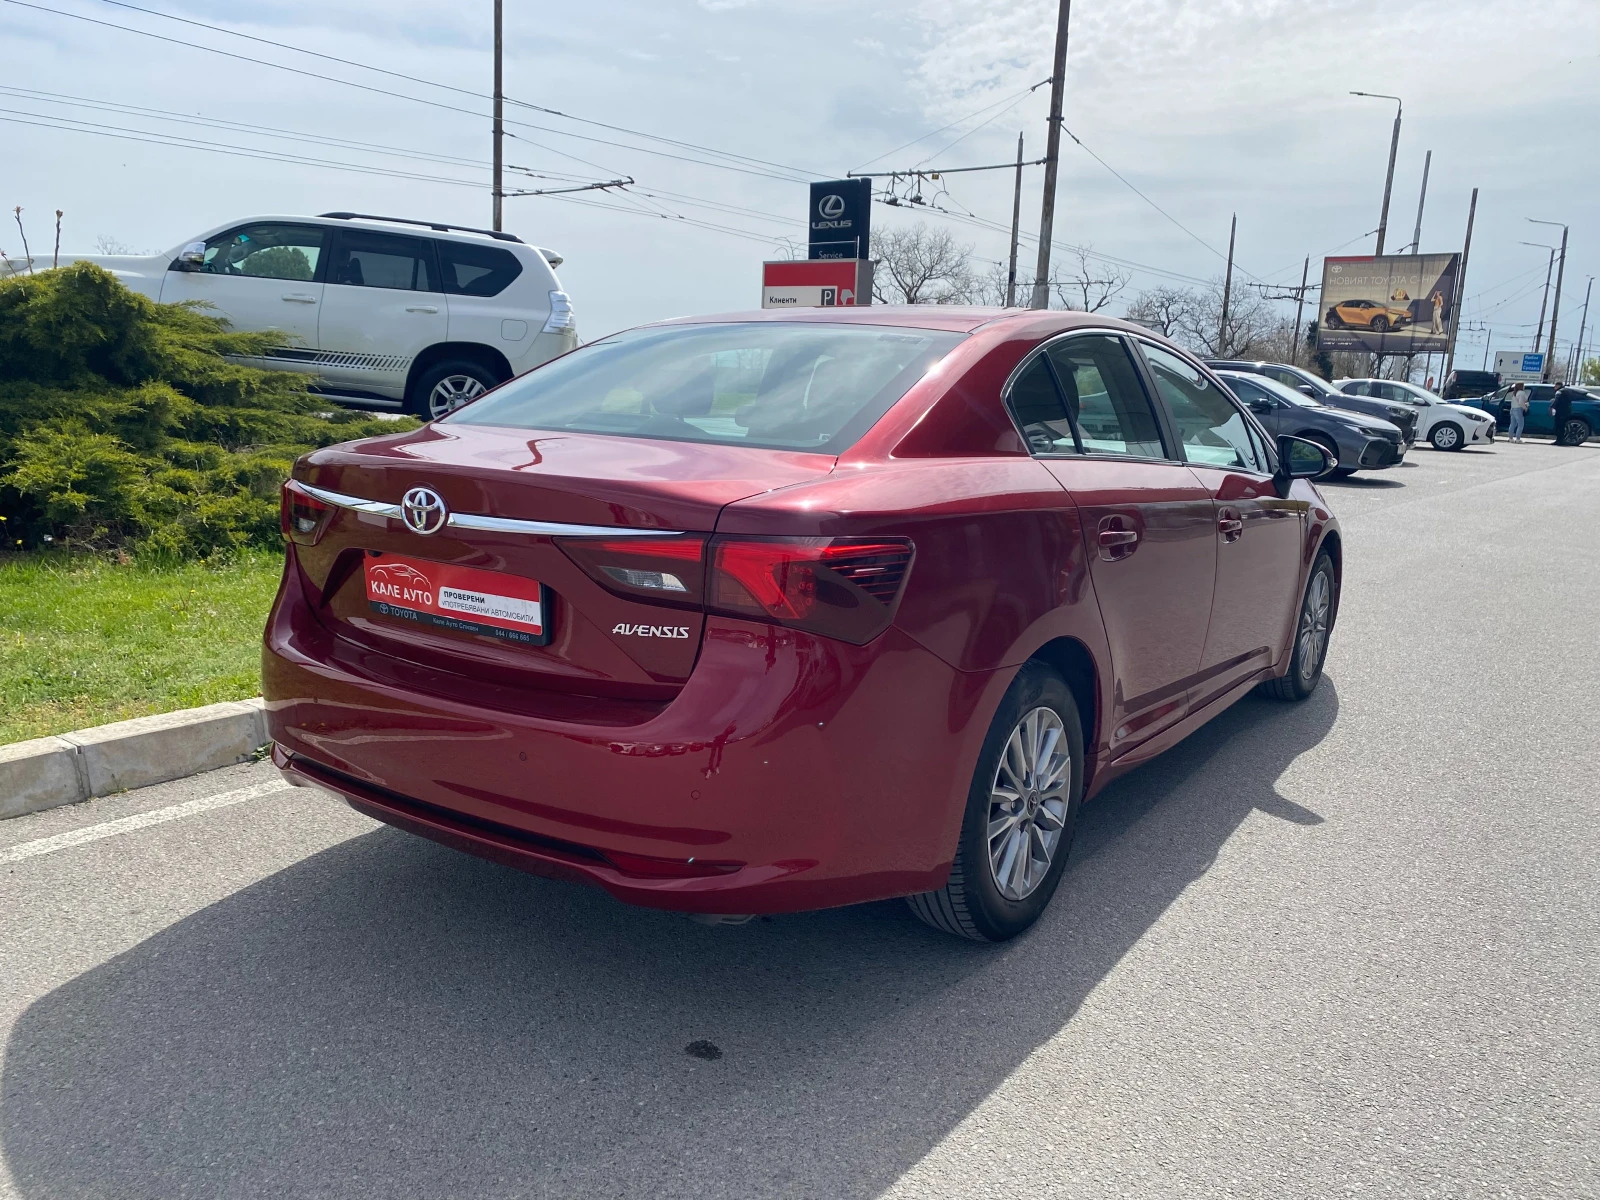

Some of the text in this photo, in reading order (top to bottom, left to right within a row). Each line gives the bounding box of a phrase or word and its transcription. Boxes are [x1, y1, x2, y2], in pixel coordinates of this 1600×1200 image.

[812, 220, 852, 229] LEXUS
[819, 251, 843, 259] Service
[1329, 276, 1368, 285] НОВИЯТ
[1371, 275, 1407, 285] TOYOTA
[769, 296, 797, 304] Клиенти
[371, 580, 432, 605] КАЛЕ АУТО
[444, 591, 485, 604] ПРОВЕРЕНИ
[390, 607, 418, 620] TOYOTA
[442, 600, 534, 622] УПОТРЕБЯВАНИ АВТОМОБИЛИ
[433, 617, 445, 626] Кале
[612, 623, 690, 639] AVENSIS
